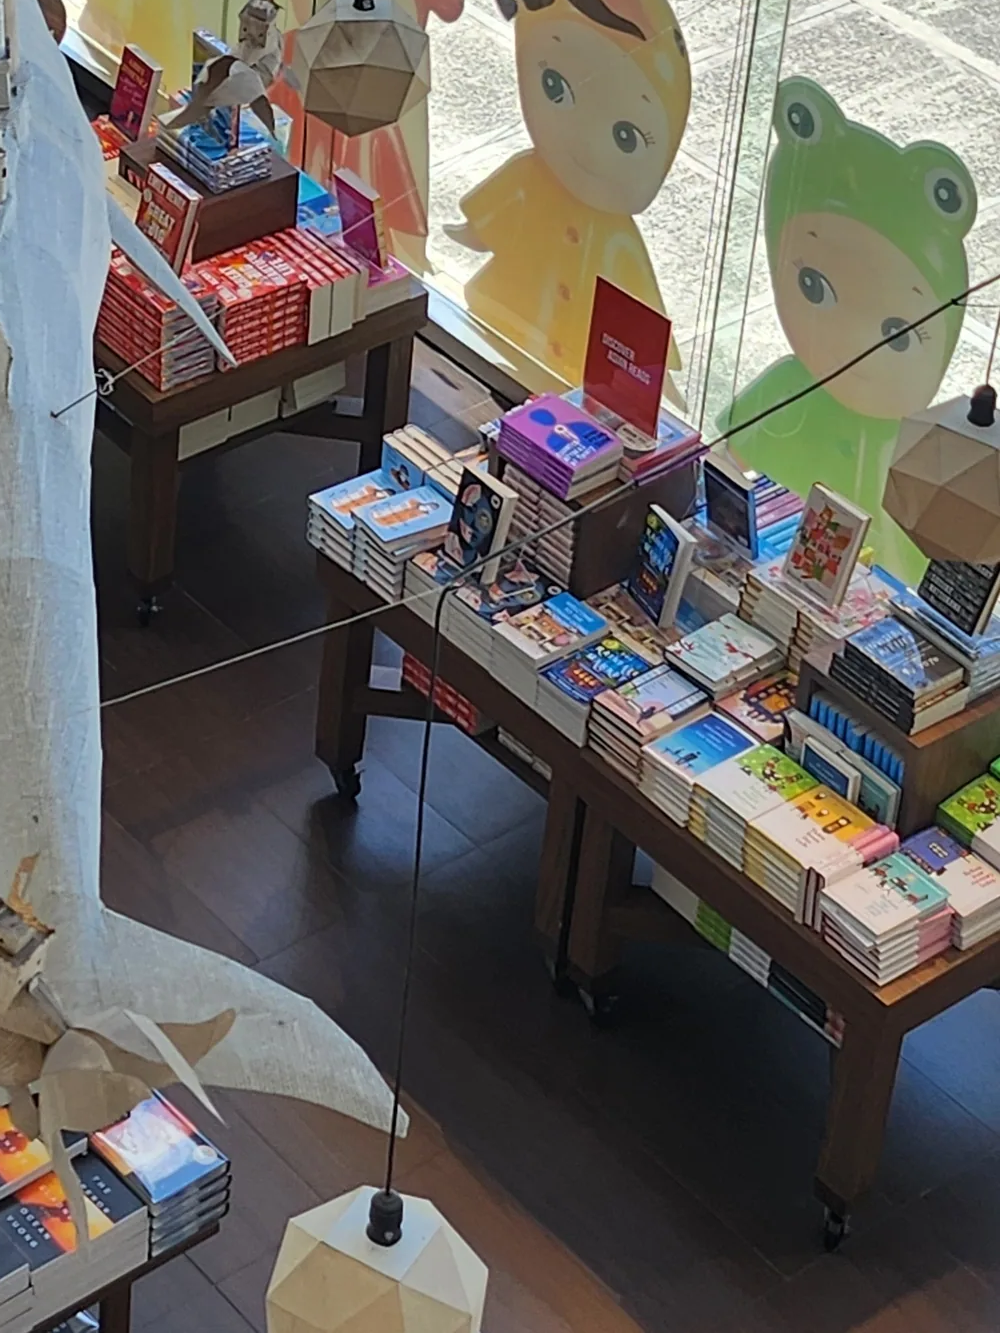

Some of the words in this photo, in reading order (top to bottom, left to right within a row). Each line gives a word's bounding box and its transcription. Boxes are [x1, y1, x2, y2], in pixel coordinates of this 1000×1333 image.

[91, 1175, 112, 1195] THE
[6, 1214, 39, 1248] VUONG
[19, 1207, 52, 1240] OCEAN
